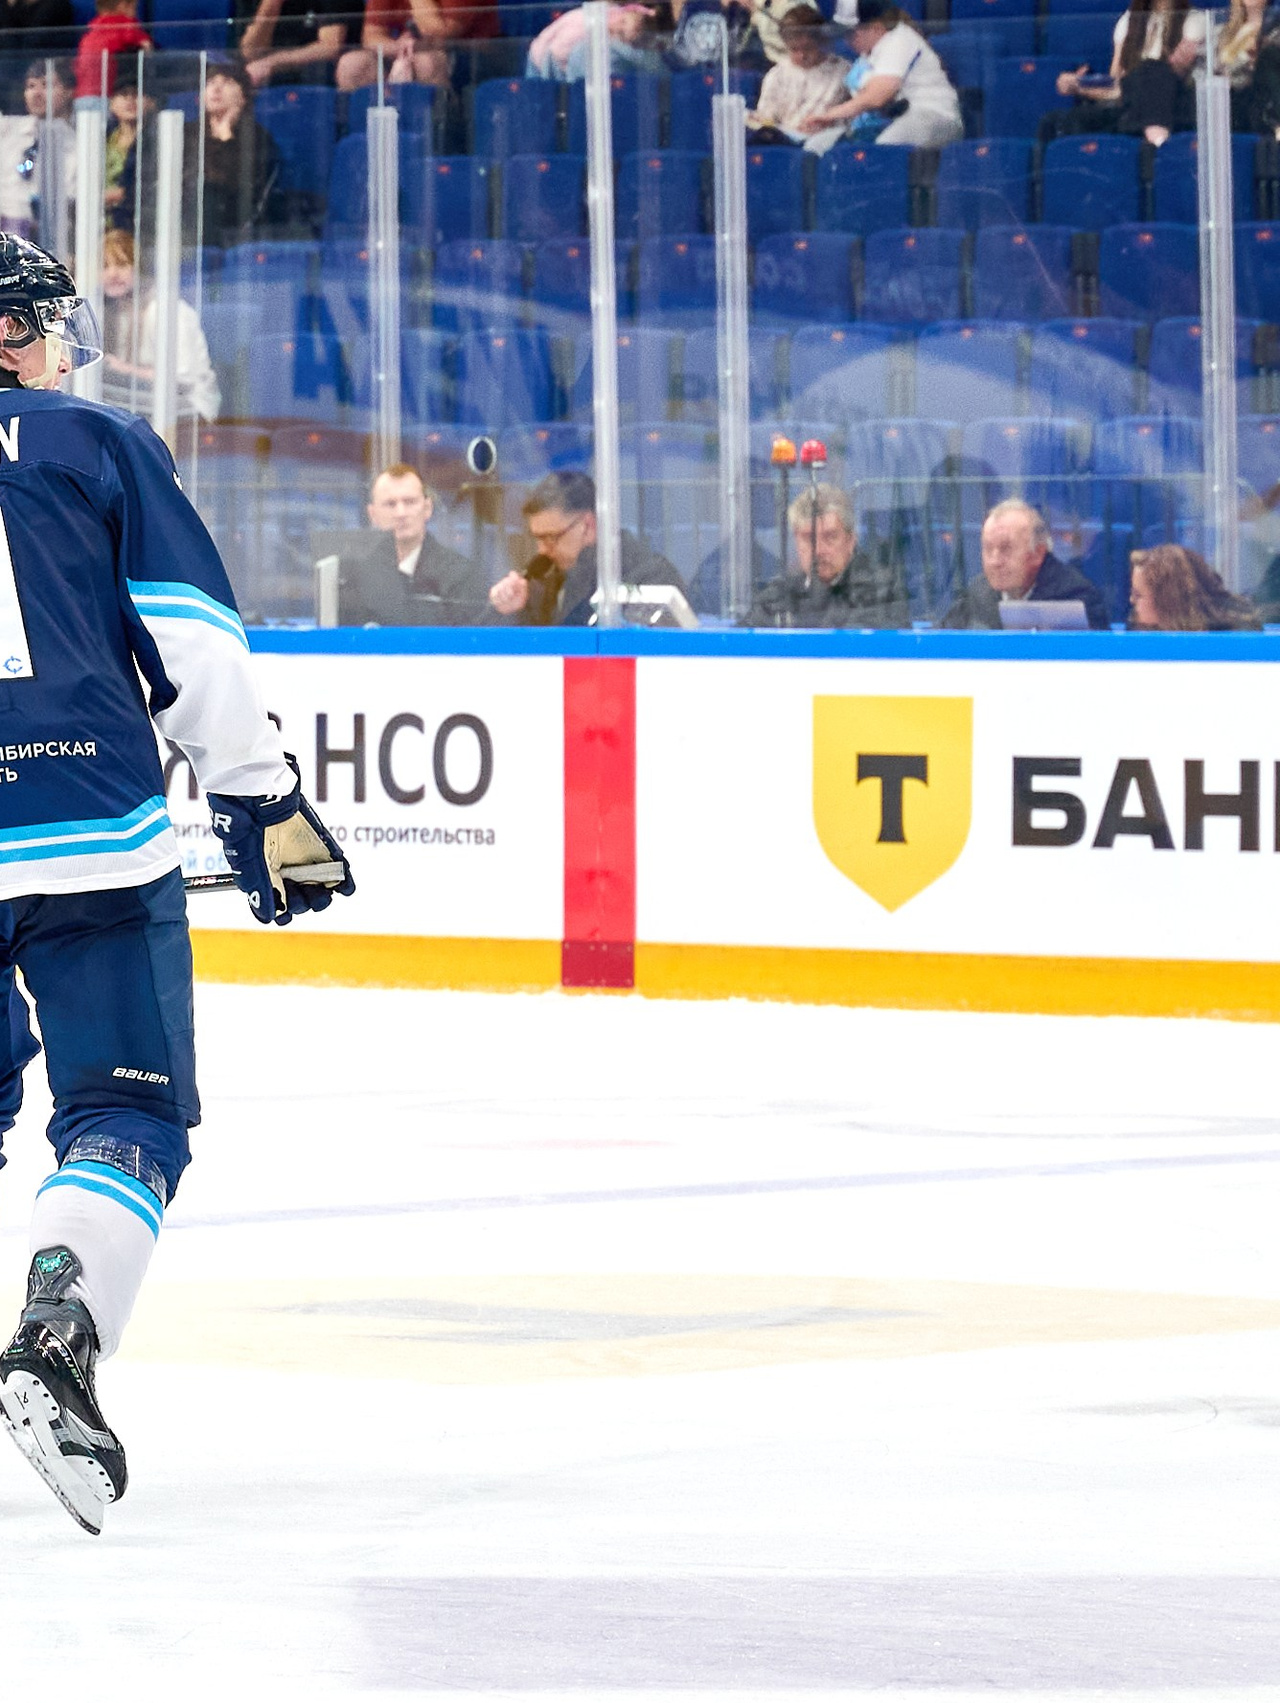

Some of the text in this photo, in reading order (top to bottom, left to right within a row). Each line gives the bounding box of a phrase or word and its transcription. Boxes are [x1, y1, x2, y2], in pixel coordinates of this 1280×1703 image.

[315, 711, 495, 807] НСО
[1011, 755, 1280, 853] БАН
[354, 825, 496, 848] строительства
[113, 1067, 170, 1086] BAUER
